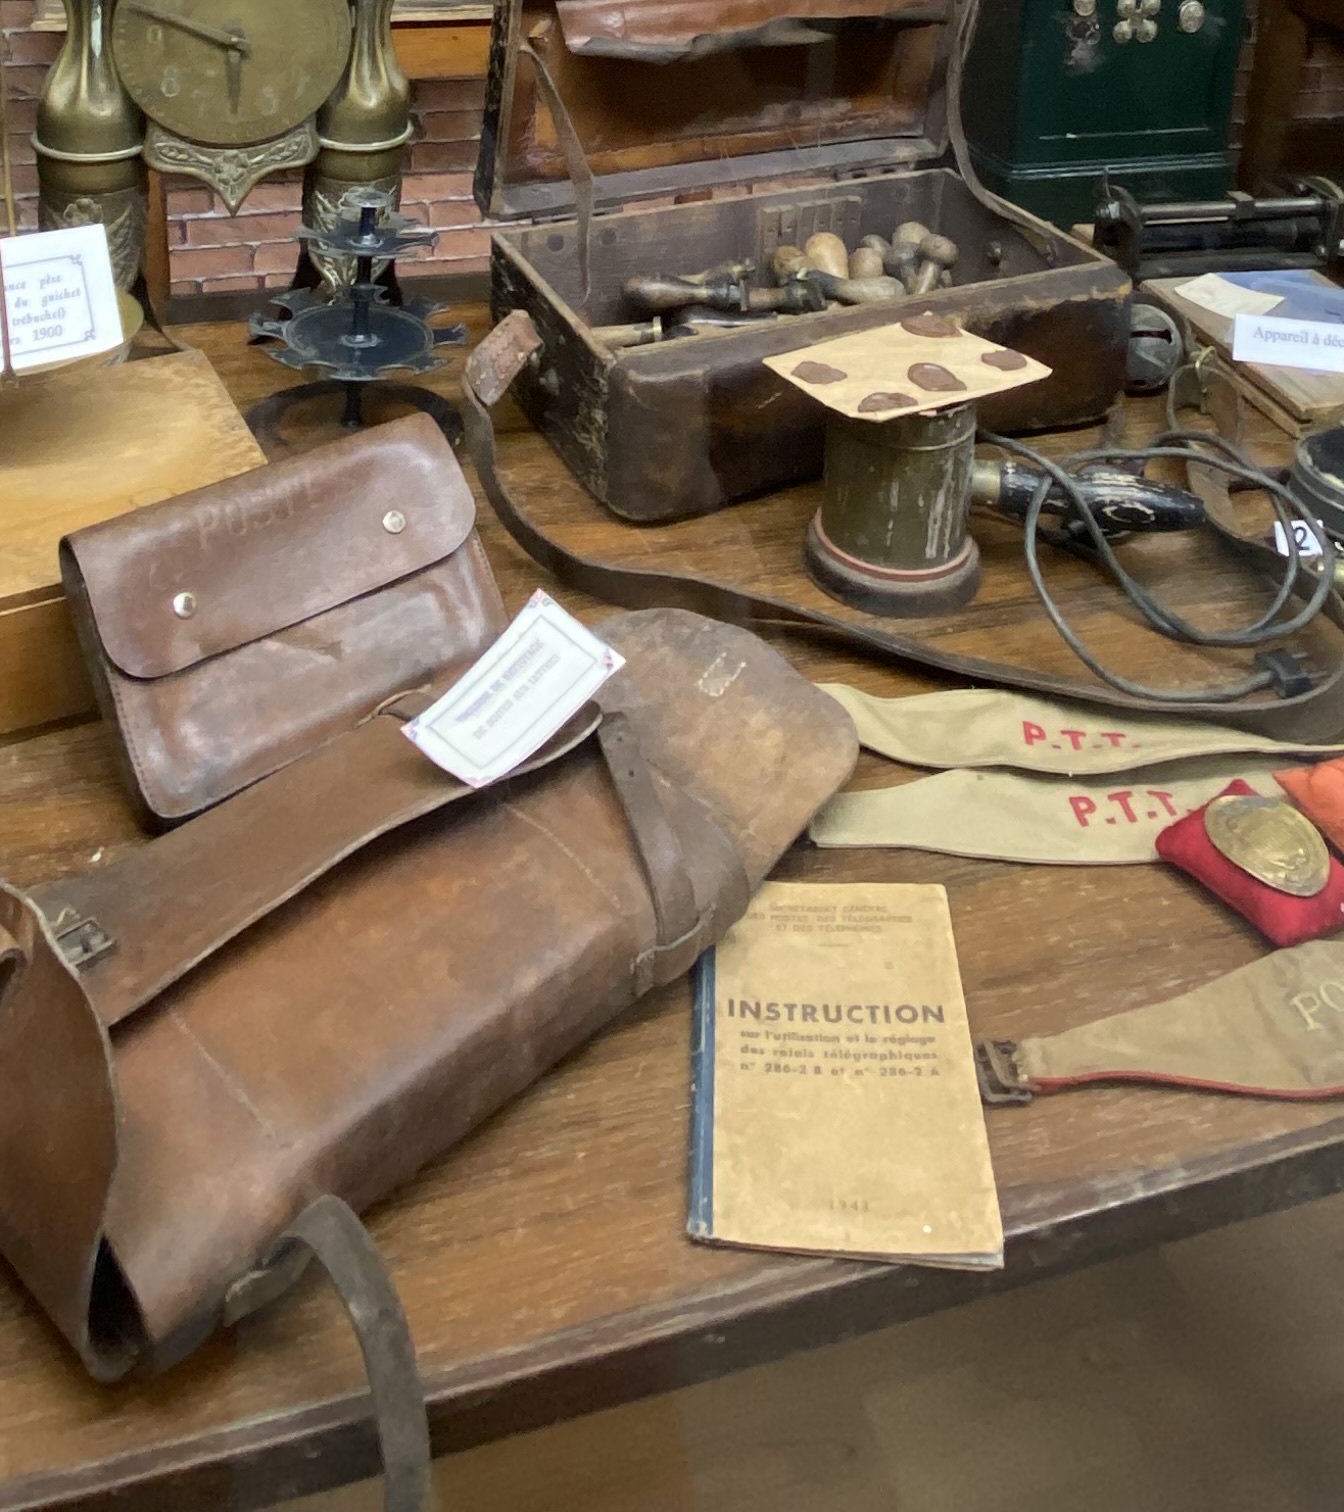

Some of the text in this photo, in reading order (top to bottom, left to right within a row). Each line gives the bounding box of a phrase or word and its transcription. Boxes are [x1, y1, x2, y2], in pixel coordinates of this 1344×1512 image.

[33, 325, 63, 342] 1900
[1253, 326, 1309, 345] Appareil
[1312, 333, 1320, 345] à
[727, 998, 945, 1025] INSTRUCTION
[740, 1044, 765, 1055] des
